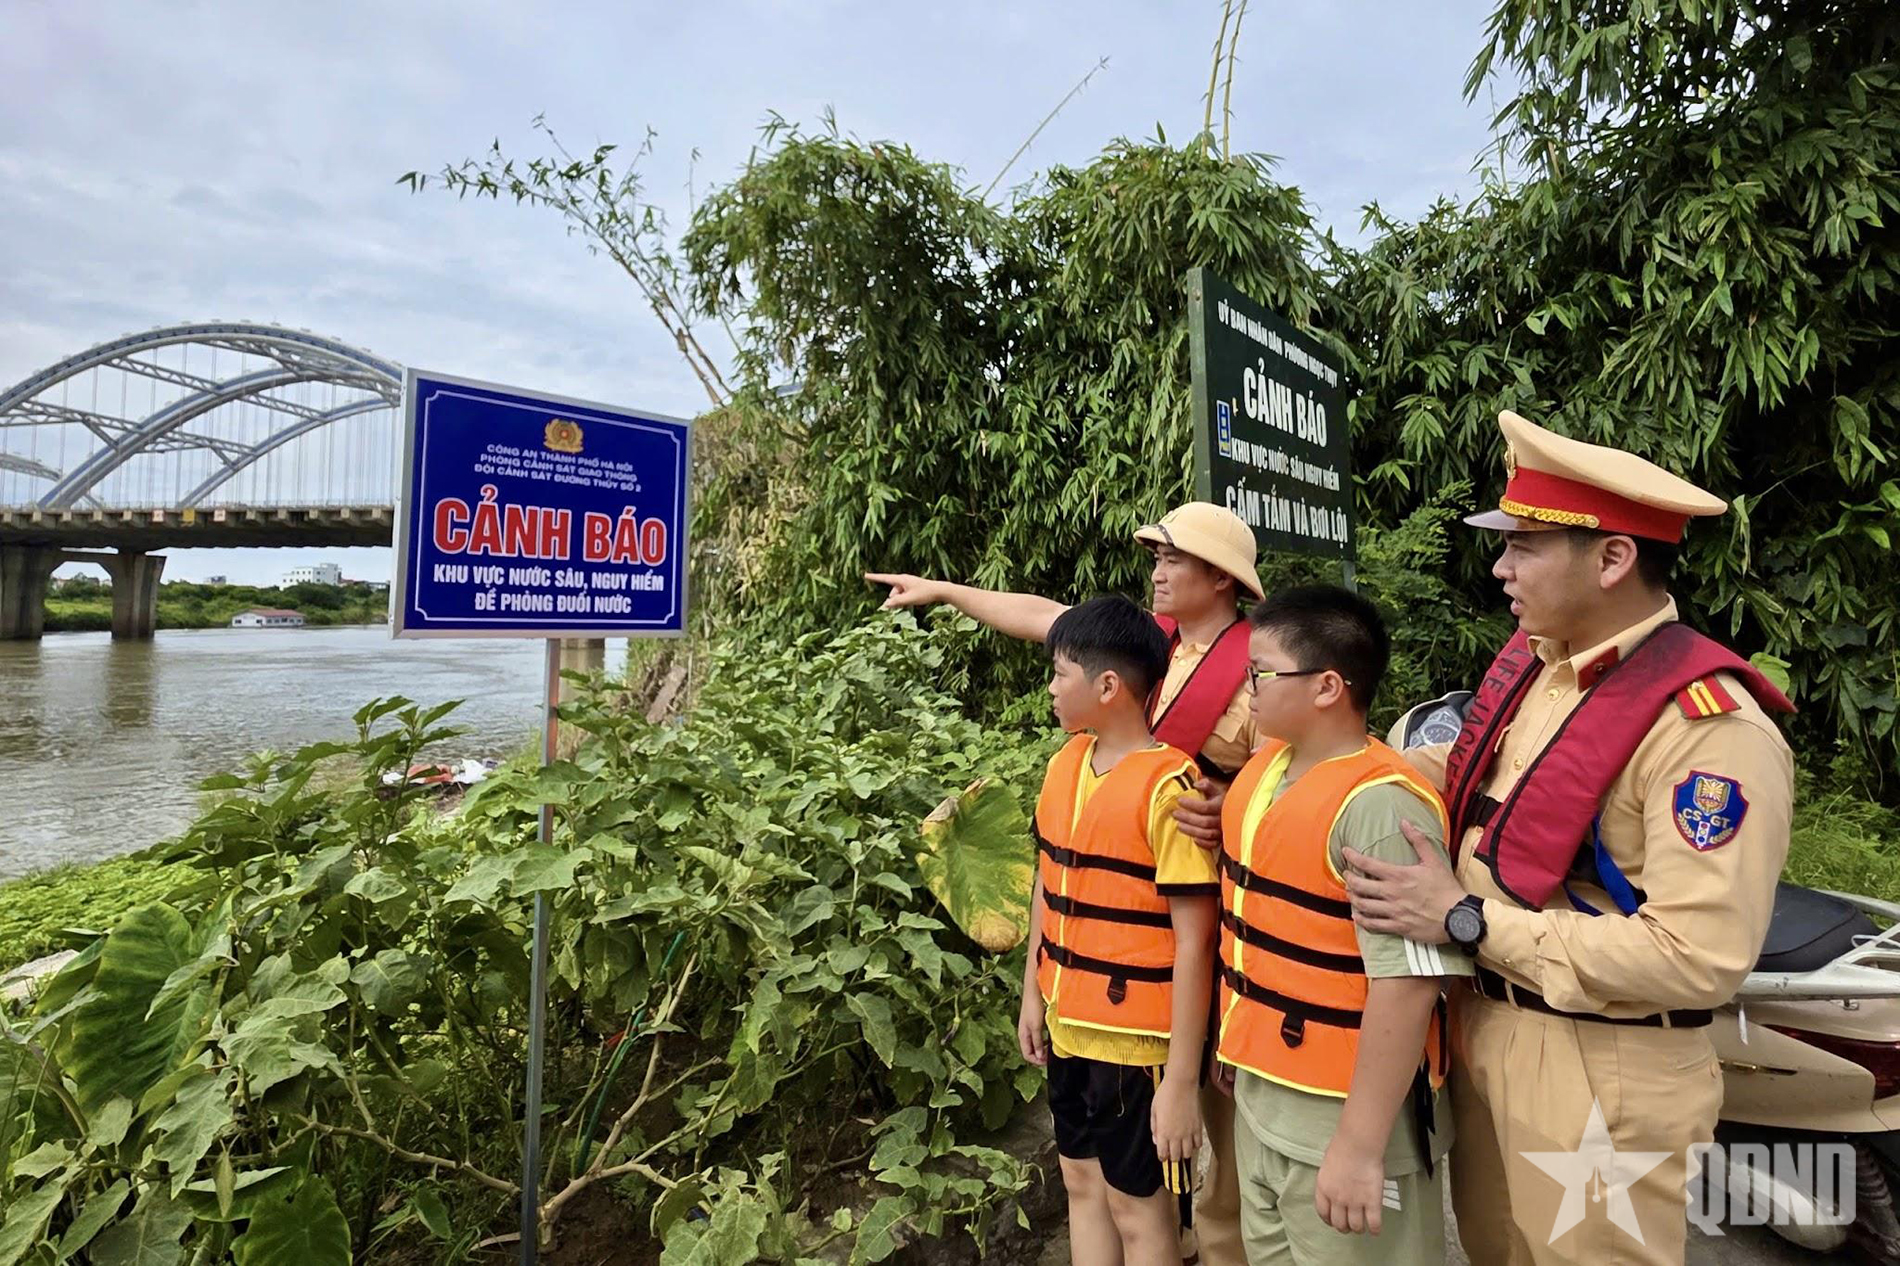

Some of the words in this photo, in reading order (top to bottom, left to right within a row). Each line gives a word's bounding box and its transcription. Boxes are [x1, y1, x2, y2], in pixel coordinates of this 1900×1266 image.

[1230, 308, 1247, 335] BAN
[1247, 318, 1268, 347] NHÂN
[1268, 330, 1283, 356] DÂN
[1243, 356, 1294, 434] CẢNH
[1295, 389, 1327, 447] BÁO
[487, 443, 520, 457] CÔNG
[522, 449, 537, 459] AN
[540, 451, 576, 464] THÀNH
[601, 460, 614, 470] HÀ
[523, 458, 553, 471] CẢNH
[577, 466, 603, 478] GIAO
[605, 469, 637, 482] THÔNG
[1231, 437, 1250, 465] KHU
[1250, 443, 1268, 474] VỰC
[1268, 446, 1289, 475] NƯỚC
[1290, 455, 1304, 482] SÂU
[1304, 462, 1322, 487] NGUY
[496, 465, 529, 478] CẢNH
[635, 484, 641, 493] 2
[433, 483, 572, 561] CẢNH
[583, 505, 667, 567] BÁO
[1225, 476, 1260, 527] CẤM
[1292, 497, 1309, 537] VÀ
[1309, 505, 1330, 540] BƠI
[1330, 506, 1348, 549] LỘI
[433, 563, 470, 584] KHU
[473, 566, 505, 588] VỰC
[508, 566, 551, 588] NƯỚC
[554, 567, 588, 590] SÂU,
[591, 572, 628, 590] NGUY
[594, 593, 632, 614] NƯỚC
[1483, 648, 1534, 694] LIFE
[1682, 807, 1703, 822] CS
[1710, 814, 1731, 829] GT
